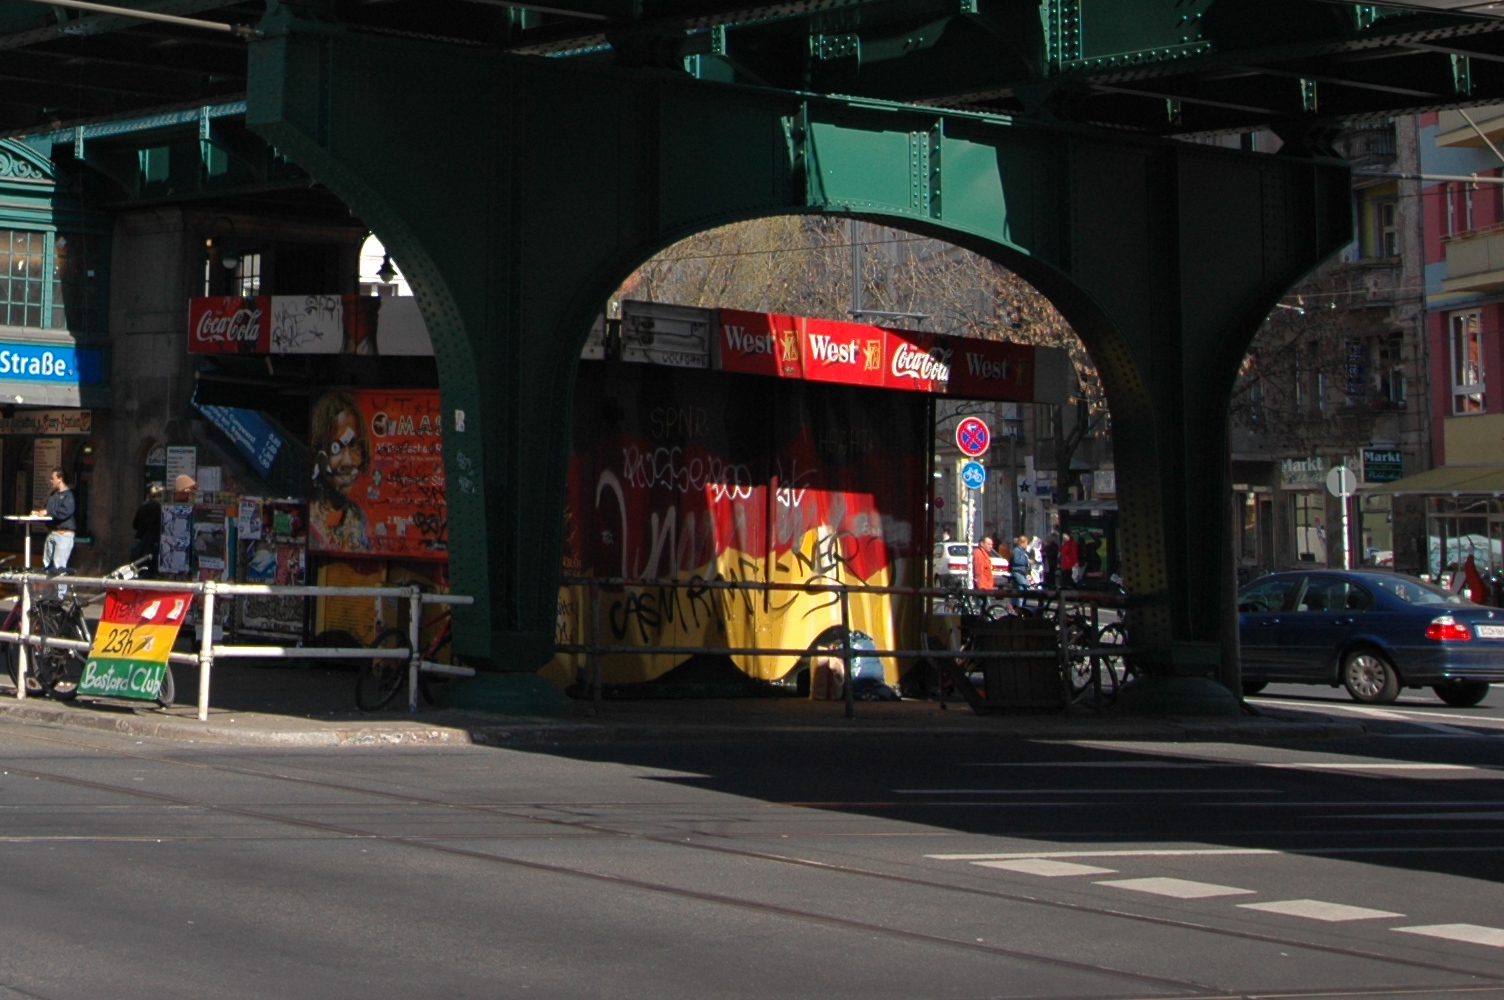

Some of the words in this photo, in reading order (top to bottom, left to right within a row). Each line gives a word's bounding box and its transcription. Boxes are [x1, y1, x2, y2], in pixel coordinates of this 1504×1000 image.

[196, 308, 263, 343] Coca-Cola
[723, 324, 774, 355] West
[0, 350, 66, 376] Straße
[809, 333, 857, 364] West
[891, 342, 954, 382] Coca-Cola
[966, 352, 1009, 380] West
[398, 415, 442, 436] MAS
[1364, 452, 1401, 463] Markt
[101, 628, 133, 656] 23h
[130, 664, 162, 694] Club
